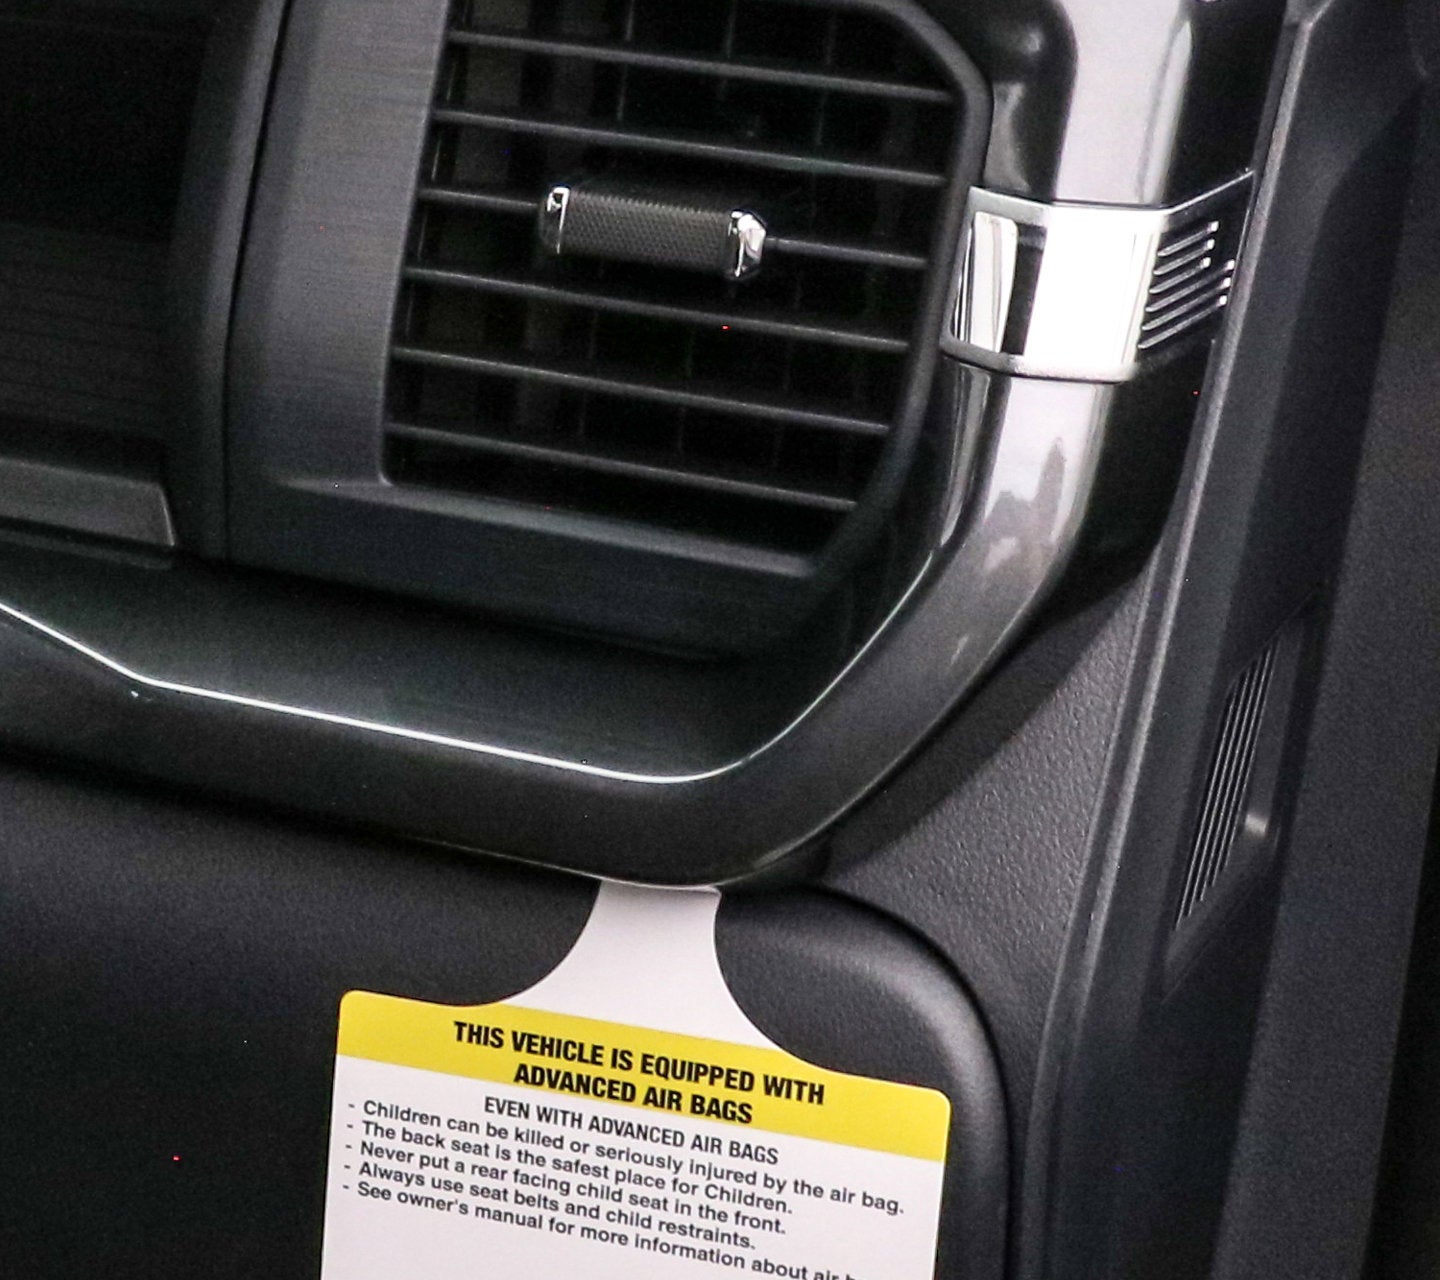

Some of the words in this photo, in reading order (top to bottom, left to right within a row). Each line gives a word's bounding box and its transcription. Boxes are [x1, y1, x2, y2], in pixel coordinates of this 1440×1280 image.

[453, 1020, 505, 1049] THIS
[510, 1030, 605, 1067] VEHICLE
[610, 1047, 634, 1072] IS
[639, 1052, 756, 1093] EQUIPPED
[762, 1073, 825, 1106] WITH
[513, 1062, 637, 1104] ADVANCED
[641, 1085, 683, 1113] AIR
[689, 1093, 753, 1125] BAGS
[361, 1119, 397, 1140] The
[401, 1126, 446, 1150] back
[450, 1139, 490, 1158] seat
[495, 1143, 512, 1162] is
[516, 1148, 547, 1168] the
[551, 1158, 610, 1180] safest
[614, 1168, 666, 1190] place
[671, 1177, 700, 1196] for
[704, 1183, 793, 1214] Children.
[363, 1099, 441, 1128] Children
[446, 1118, 480, 1135] can
[485, 1121, 509, 1140] be
[514, 1126, 565, 1151] killed
[569, 1140, 591, 1155] or
[595, 1145, 684, 1176] seriously
[689, 1158, 758, 1186] injured
[762, 1172, 788, 1195] by
[793, 1179, 825, 1199] the
[829, 1187, 856, 1204] air
[861, 1191, 904, 1216] bag.
[484, 1095, 531, 1120] EVEN
[535, 1104, 583, 1130] WITH
[587, 1115, 685, 1148] ADVANCED
[690, 1133, 723, 1156] AIR
[728, 1140, 779, 1166] BAGS
[357, 1180, 392, 1201] See
[396, 1191, 469, 1216] owner's
[474, 1205, 544, 1230] manual
[548, 1216, 576, 1236] for
[580, 1226, 629, 1246] more
[634, 1233, 746, 1269] information
[358, 1161, 426, 1188] Always
[430, 1176, 465, 1194] use
[469, 1184, 509, 1203] seat
[513, 1188, 560, 1212] belts
[564, 1202, 601, 1221] and
[605, 1208, 653, 1230] child
[657, 1220, 756, 1250] restraints.
[360, 1140, 415, 1164] Never
[418, 1154, 450, 1171] put
[454, 1160, 465, 1174] a
[470, 1164, 509, 1181] rear
[512, 1168, 571, 1197] facing
[576, 1182, 624, 1204] child
[628, 1193, 669, 1212] seat
[674, 1198, 692, 1217] in
[697, 1203, 729, 1223] the
[734, 1210, 786, 1234] front.
